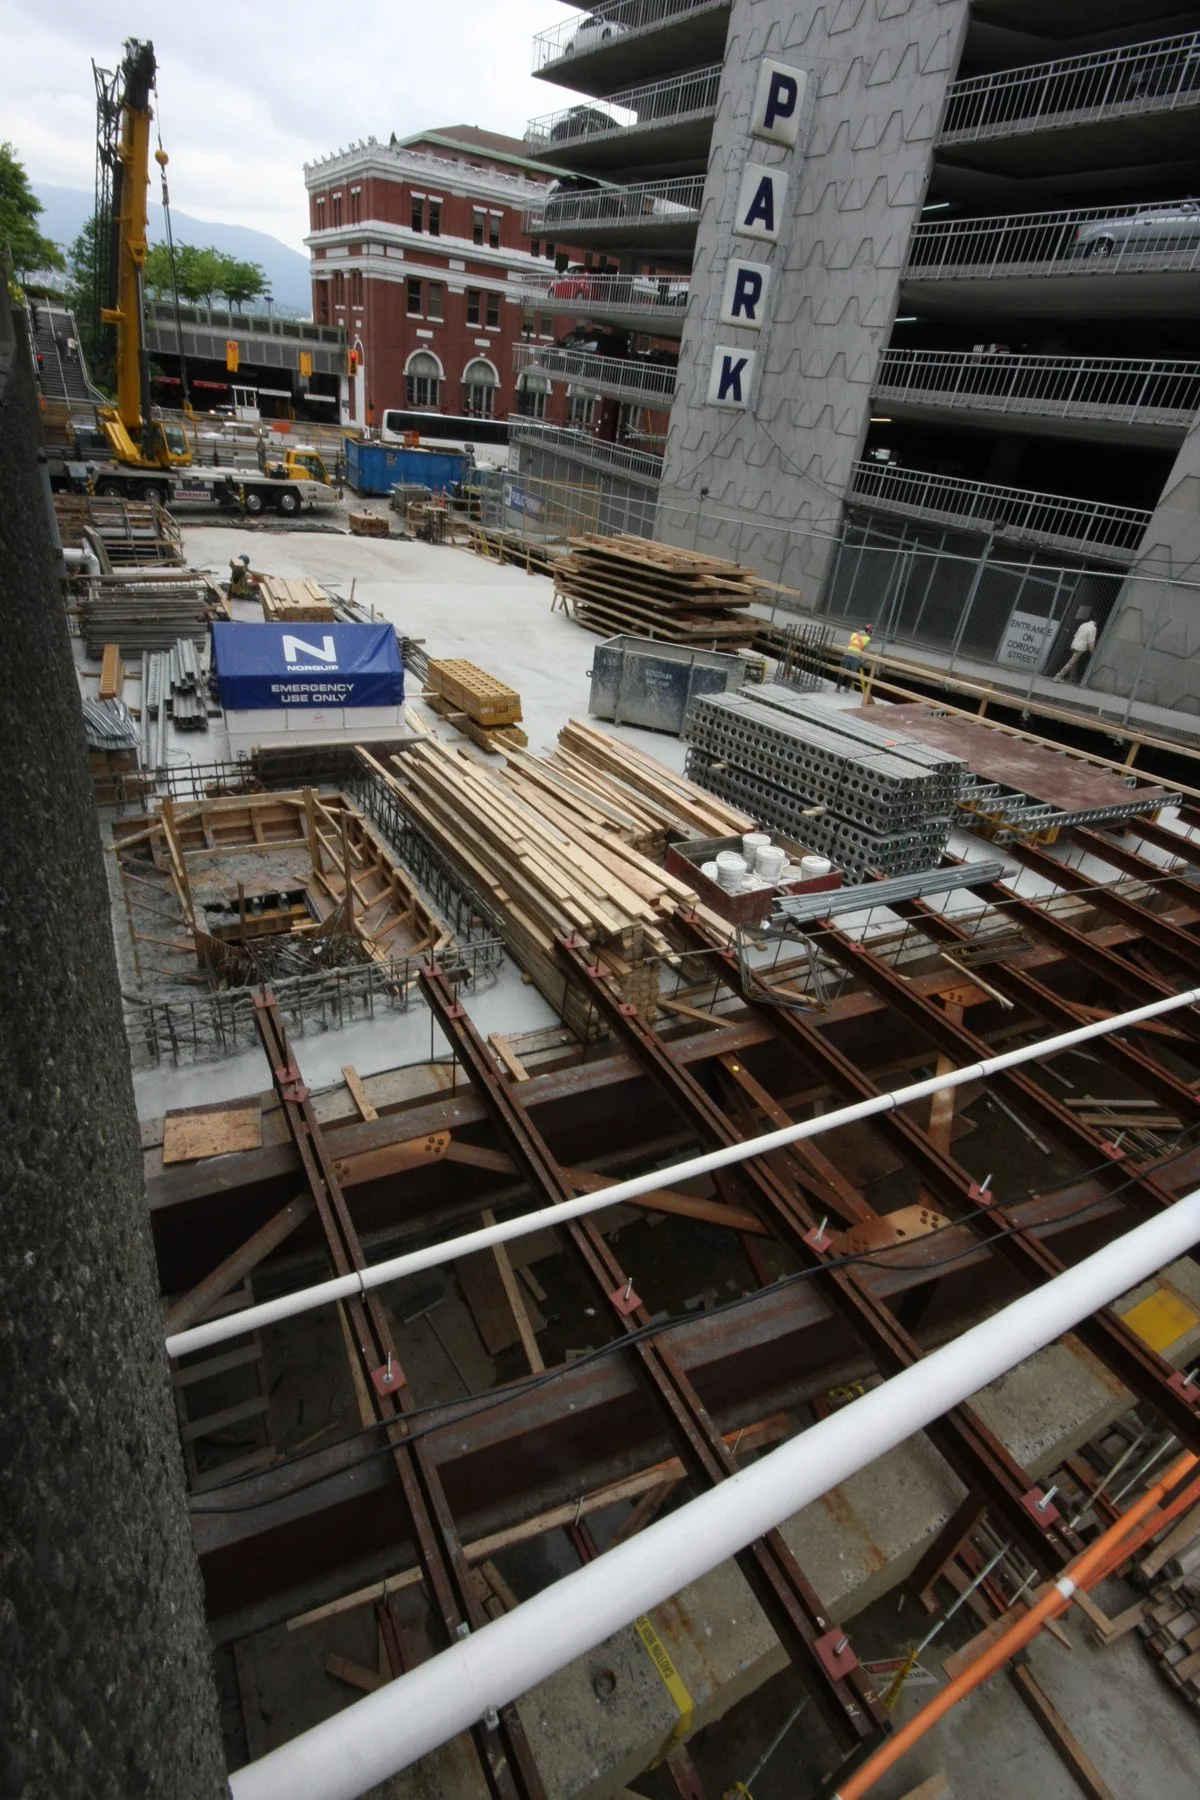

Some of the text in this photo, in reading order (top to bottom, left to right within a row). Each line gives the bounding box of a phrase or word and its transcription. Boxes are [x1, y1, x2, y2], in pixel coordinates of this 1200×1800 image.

[717, 71, 798, 402] PARK
[1010, 620, 1053, 637] ENTRANCE
[1022, 634, 1034, 643] ON
[282, 635, 337, 662] N
[1007, 651, 1038, 664] STREET
[271, 683, 355, 693] EMERGENCY
[281, 693, 347, 703] USE ONLY
